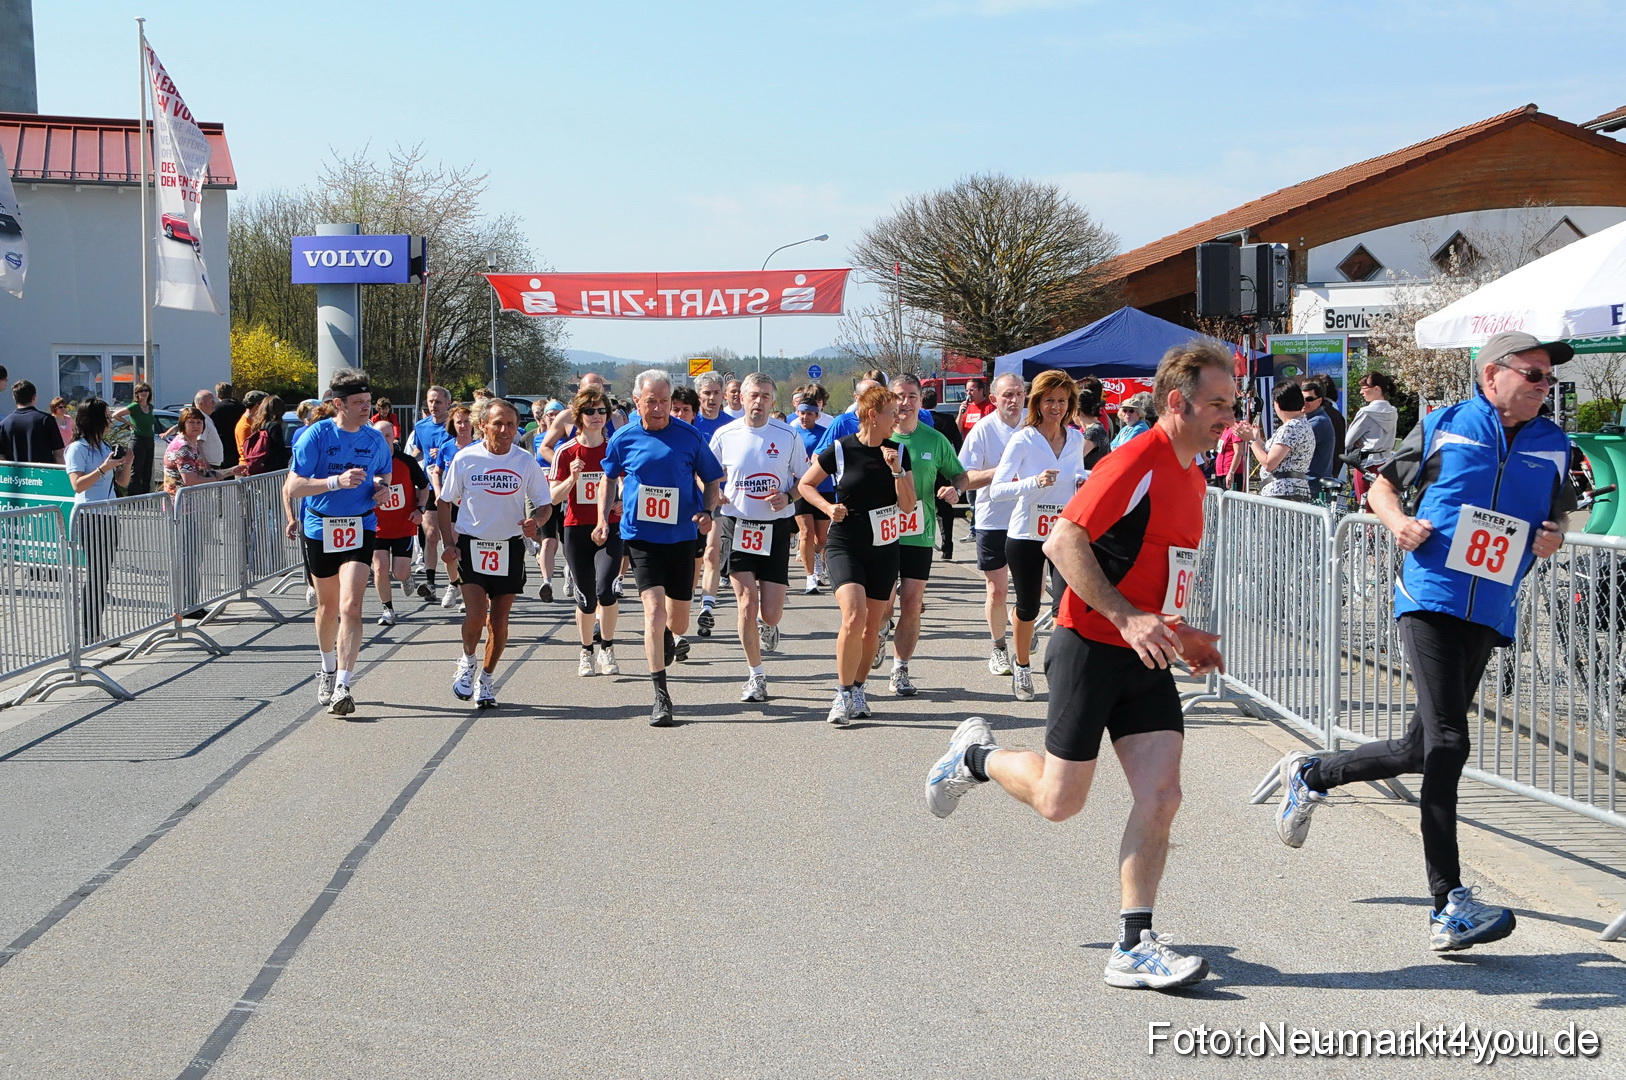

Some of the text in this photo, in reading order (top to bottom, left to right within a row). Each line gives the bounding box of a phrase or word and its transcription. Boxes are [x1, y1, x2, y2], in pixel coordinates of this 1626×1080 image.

[302, 249, 393, 267] VOLVO
[585, 481, 600, 500] 8
[735, 479, 772, 488] GERHART
[645, 497, 670, 519] 80
[1472, 511, 1506, 526] MEYER
[880, 517, 897, 541] 65
[898, 512, 918, 533] 64
[333, 527, 356, 548] 82
[741, 529, 763, 551] 53
[479, 550, 499, 572] 73
[1465, 529, 1509, 573] 83
